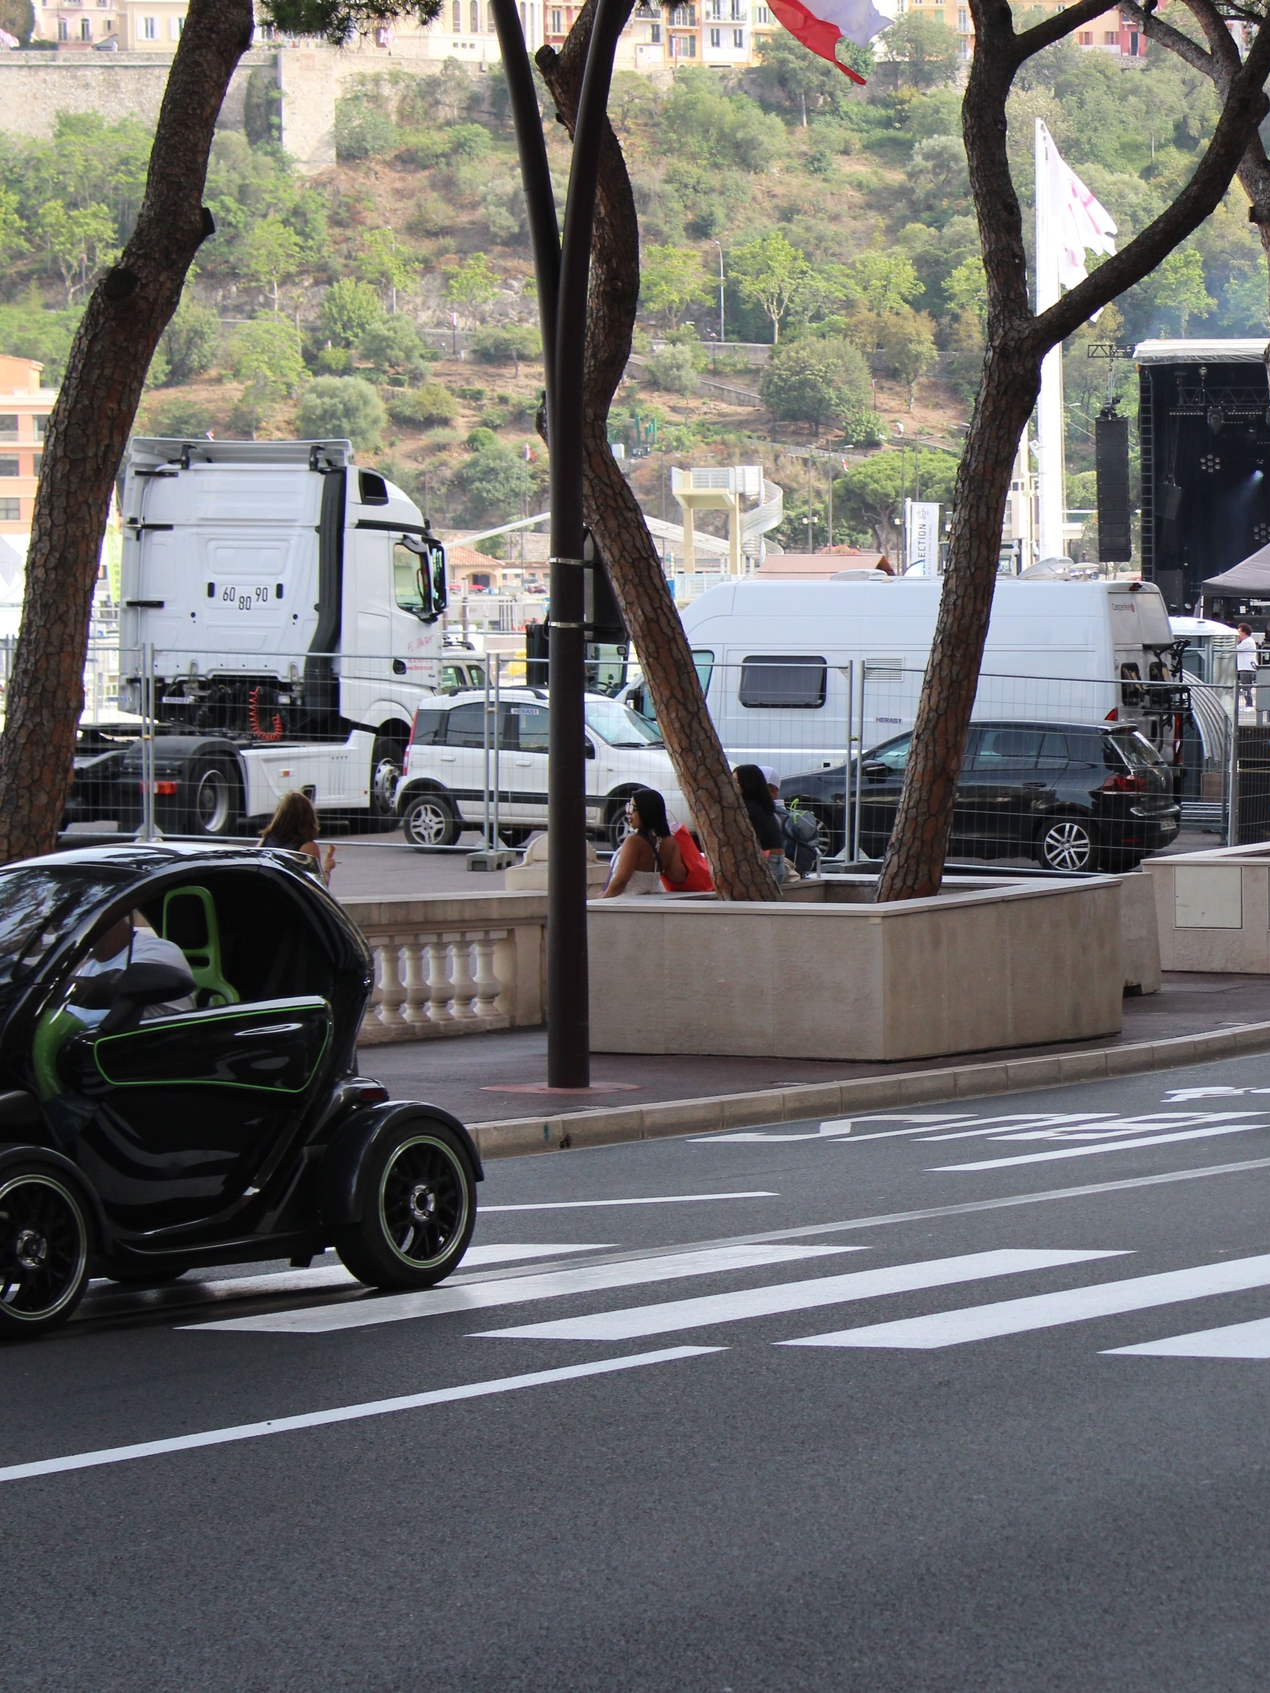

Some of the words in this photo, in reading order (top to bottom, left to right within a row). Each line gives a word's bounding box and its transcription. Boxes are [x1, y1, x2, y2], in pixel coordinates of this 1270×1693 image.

[222, 586, 236, 602] 60
[255, 586, 269, 602] 90
[238, 595, 252, 611] 80
